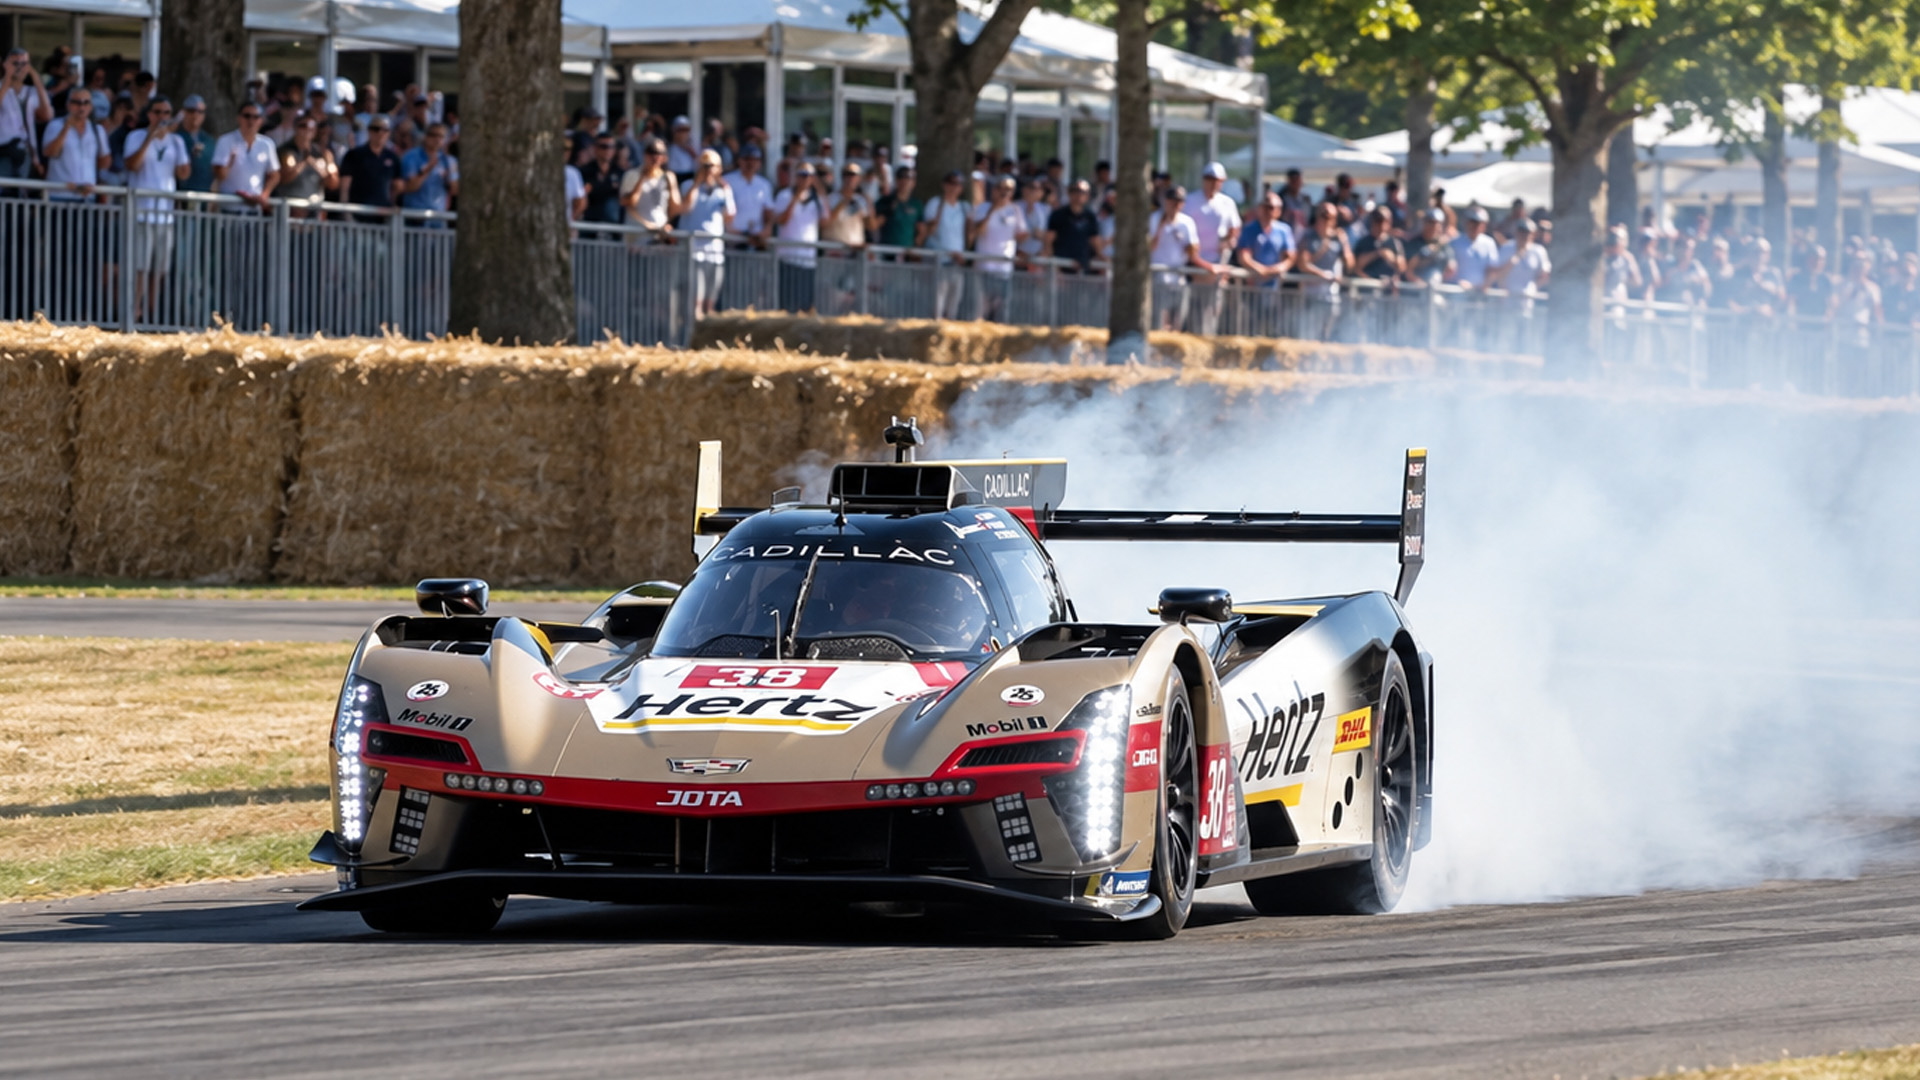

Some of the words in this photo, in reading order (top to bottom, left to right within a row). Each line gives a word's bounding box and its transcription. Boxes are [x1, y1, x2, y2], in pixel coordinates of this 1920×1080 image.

[984, 472, 1030, 499] CADILLAC
[711, 545, 955, 565] CADILLAC
[708, 667, 808, 687] 38
[397, 708, 452, 728] Mobil
[613, 694, 878, 722] Hertz
[966, 718, 1024, 737] Mobil
[656, 790, 743, 806] JOTA
[1200, 758, 1227, 839] 38
